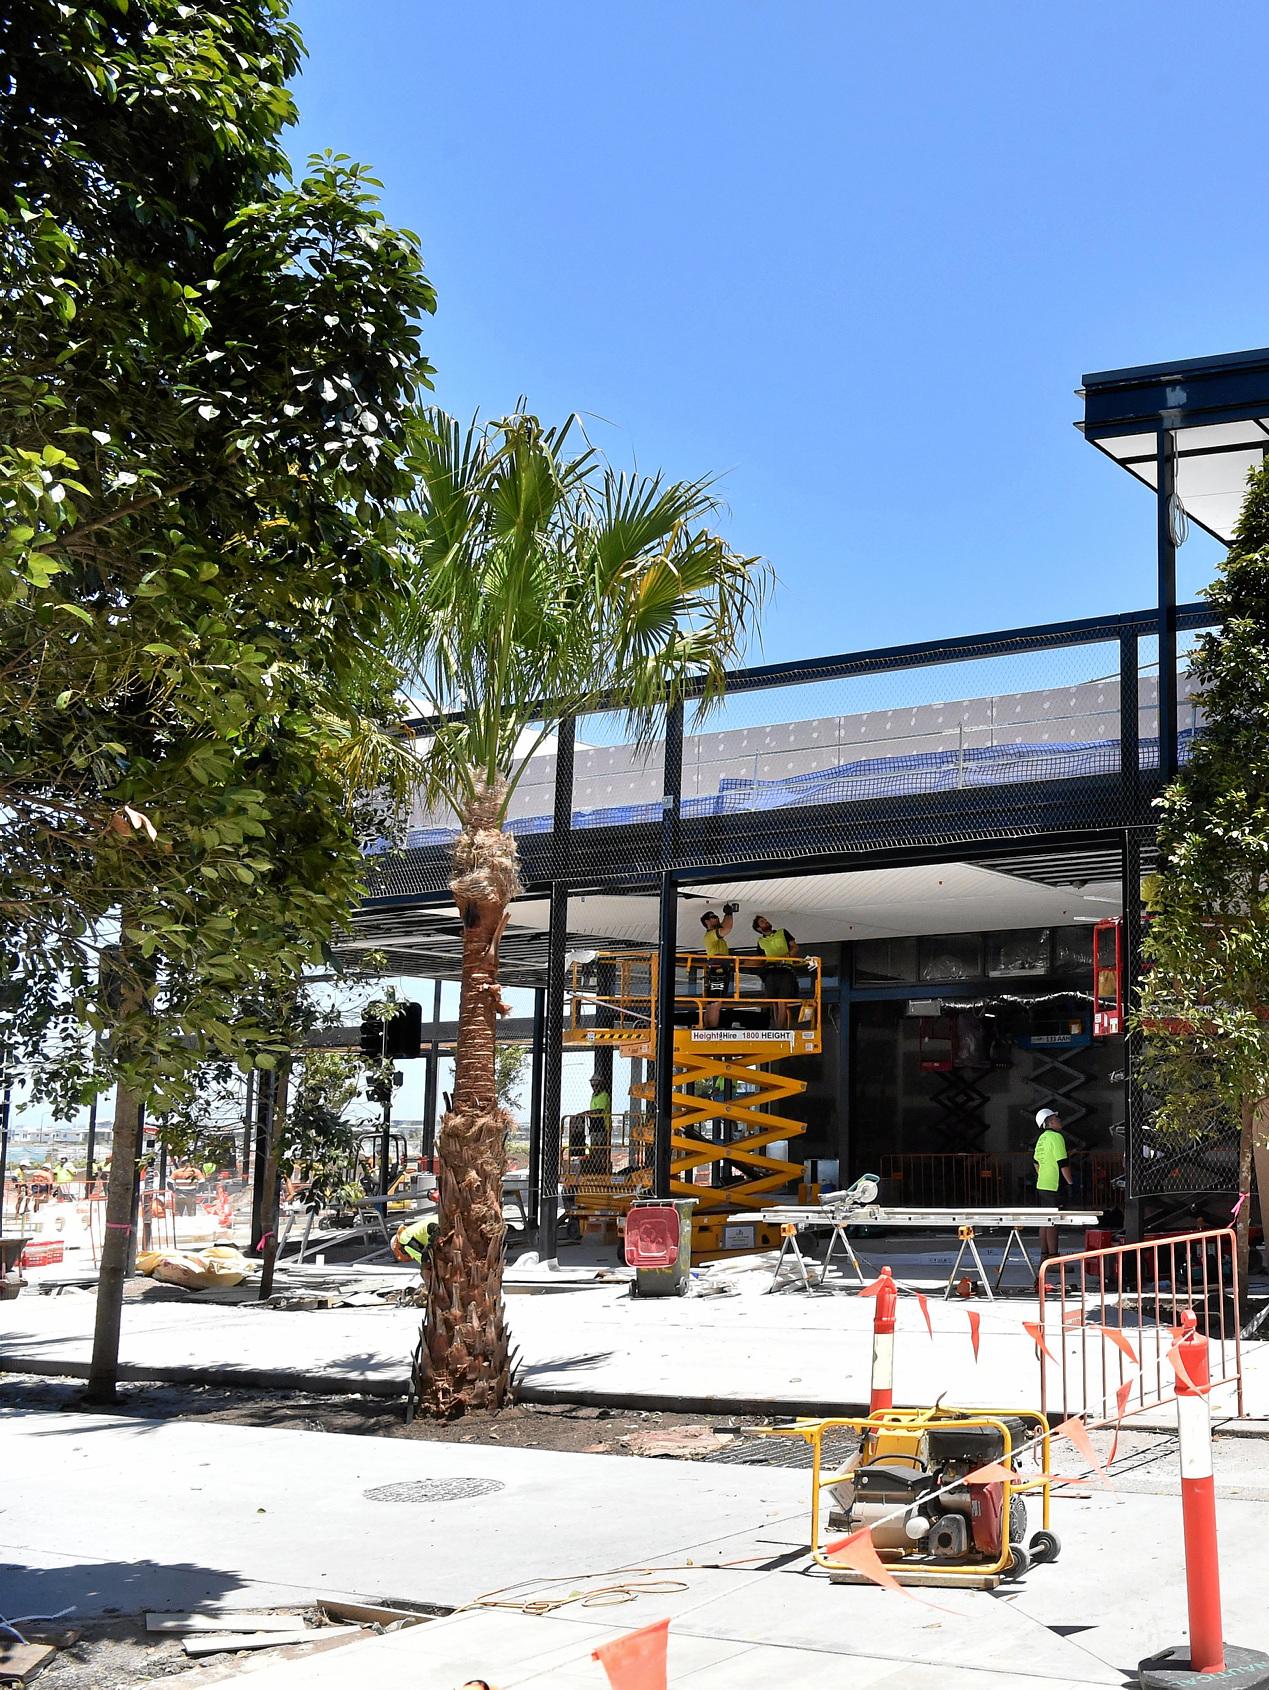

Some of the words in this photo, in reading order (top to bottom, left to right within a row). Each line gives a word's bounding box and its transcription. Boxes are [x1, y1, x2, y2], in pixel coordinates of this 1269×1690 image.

[742, 1032, 760, 1040] 1800
[761, 1032, 791, 1040] HEIGHT
[1168, 1661, 1265, 1686] NAUTICAL
